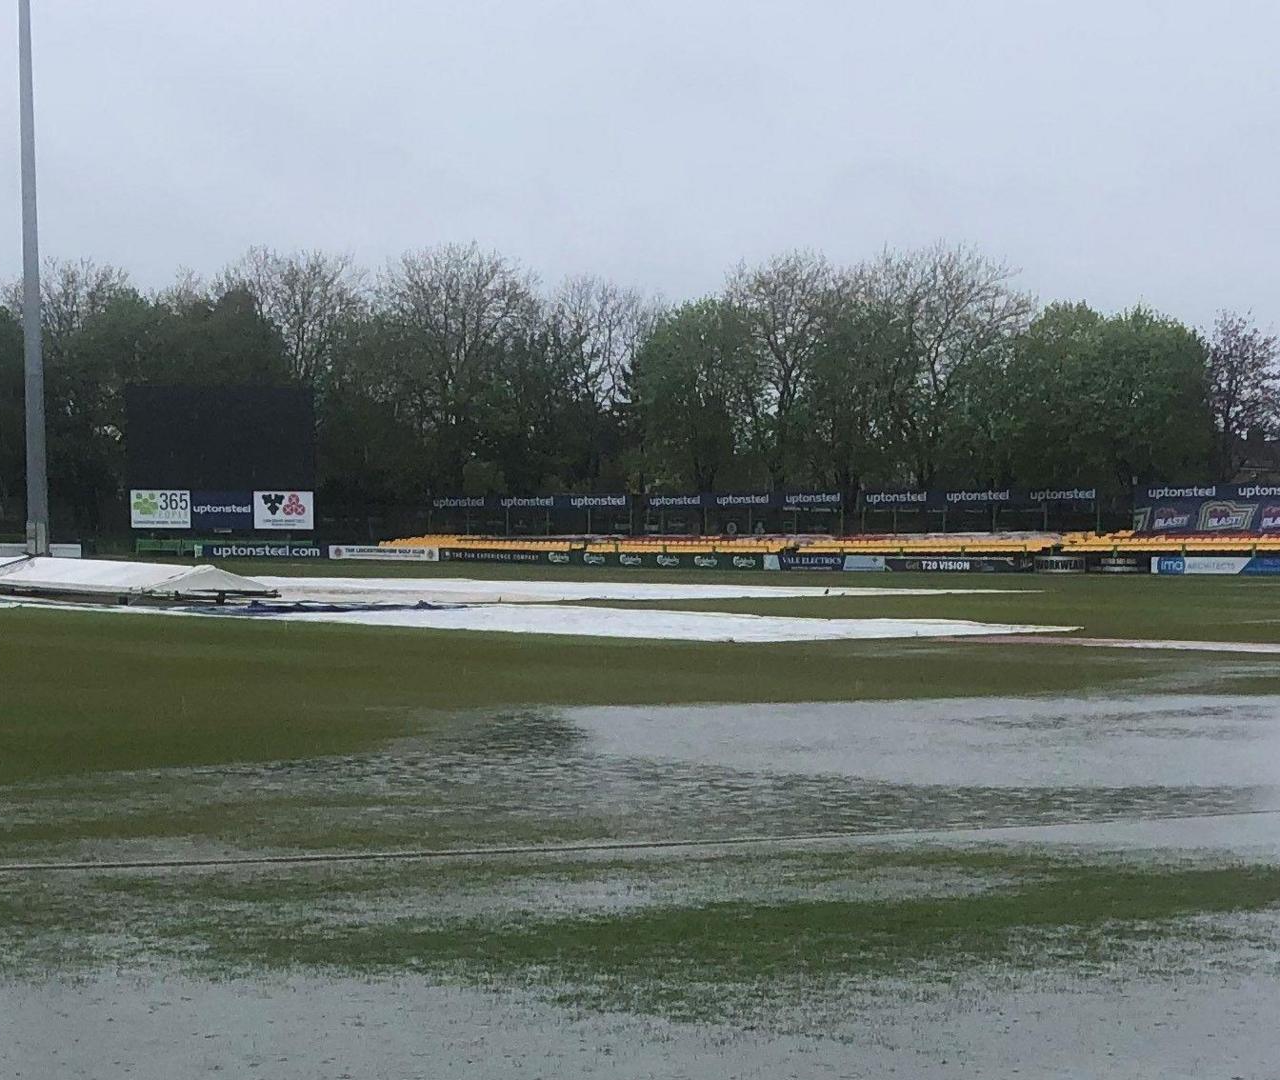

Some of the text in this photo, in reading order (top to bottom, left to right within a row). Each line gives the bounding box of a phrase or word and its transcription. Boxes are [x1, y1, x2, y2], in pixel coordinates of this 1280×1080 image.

[866, 491, 927, 504] uptonsteel
[946, 489, 1010, 502] uptonsteel
[1030, 489, 1096, 501] uptonsteel
[1148, 486, 1216, 499] uptonsteel
[160, 492, 189, 511] 365
[433, 496, 485, 509] uptonsteel
[501, 496, 554, 508] uptonsteel
[570, 495, 626, 508] uptonsteel
[650, 496, 701, 507] uptonsteel
[716, 494, 769, 505] uptonsteel
[785, 493, 841, 505] uptonsteel
[193, 504, 251, 514] uptonsteel
[213, 545, 320, 558] uptonsteel.com
[922, 561, 938, 570] T20
[939, 561, 970, 570] VISION
[1160, 560, 1183, 570] ima
